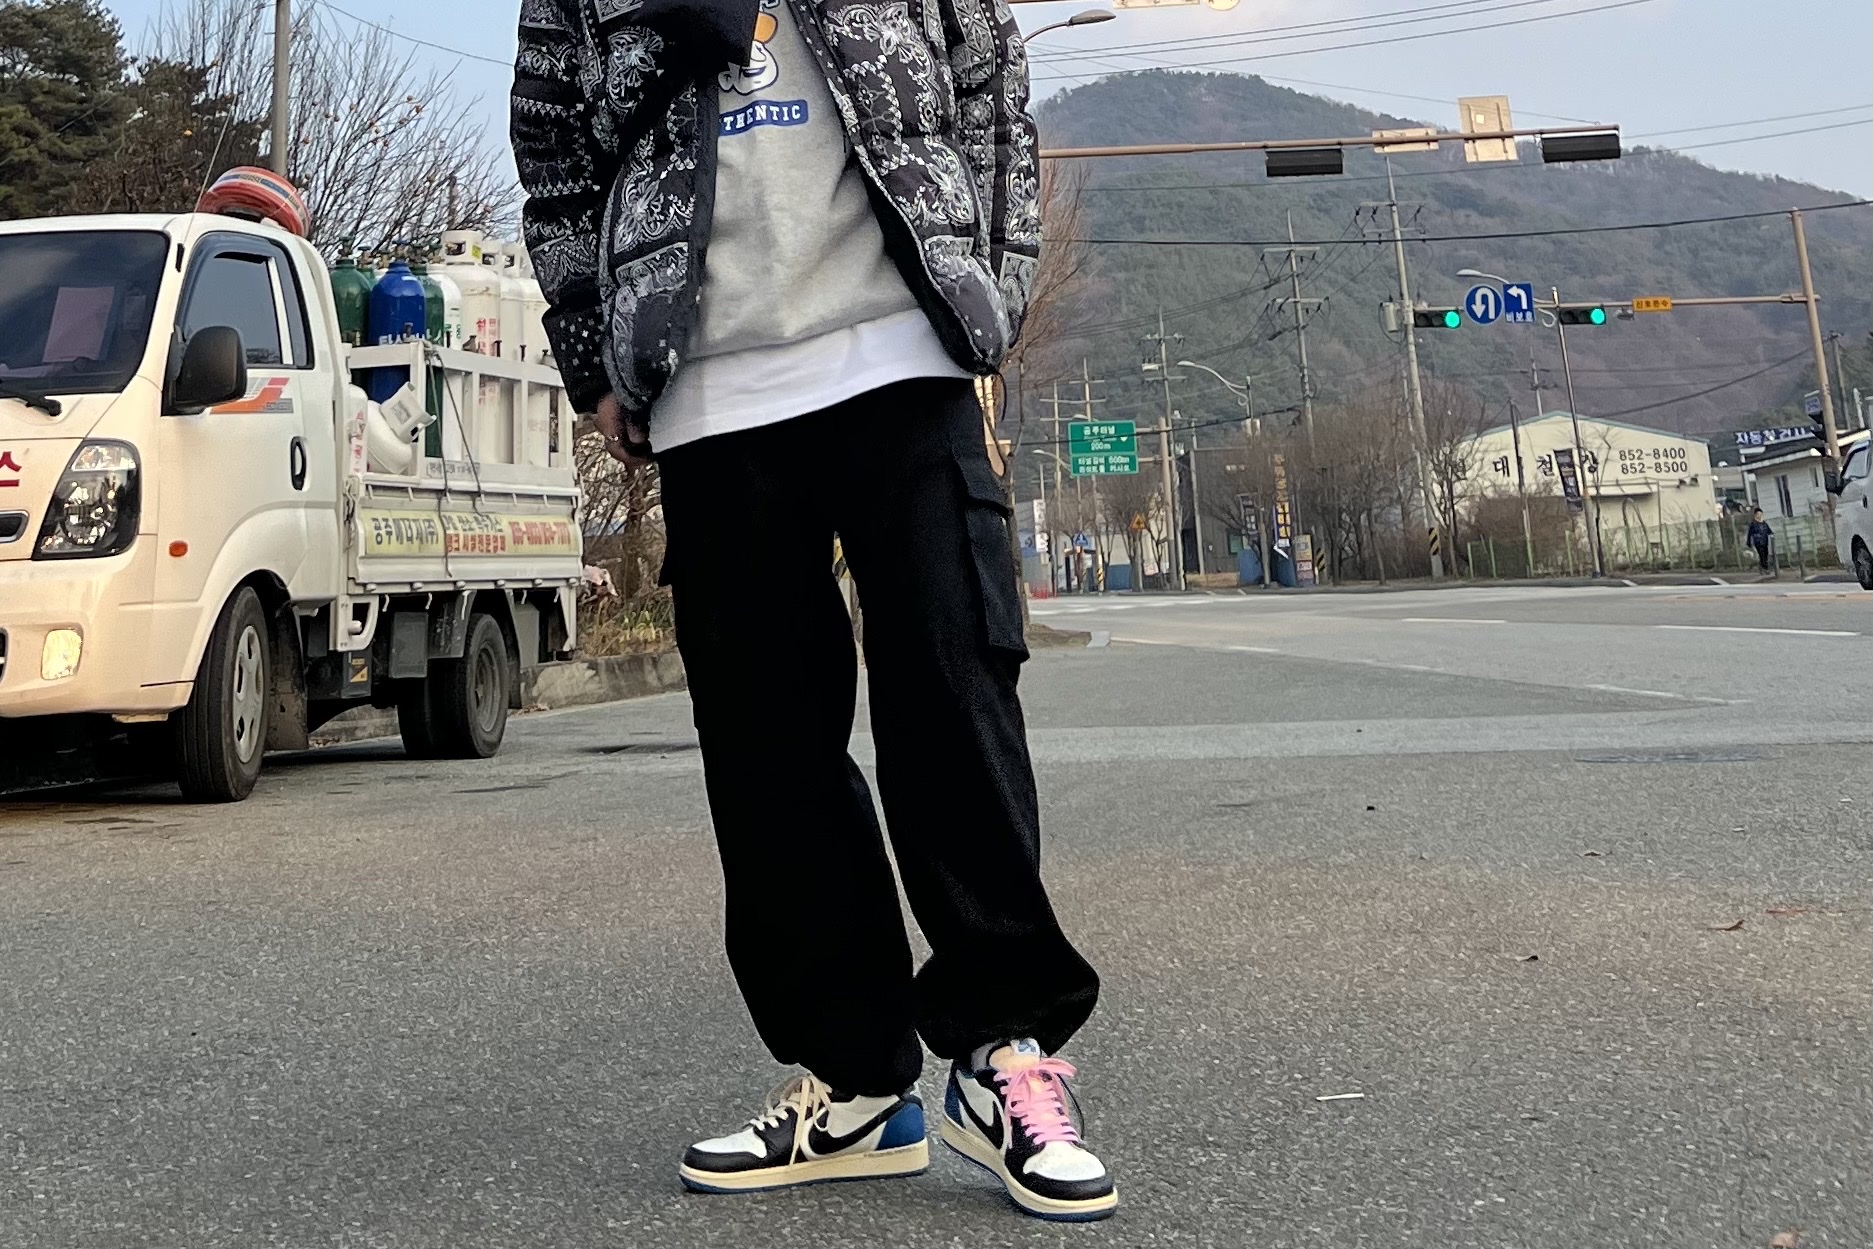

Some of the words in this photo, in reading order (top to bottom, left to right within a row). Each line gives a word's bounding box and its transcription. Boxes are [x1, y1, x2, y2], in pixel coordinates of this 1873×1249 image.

[722, 104, 801, 131] THENTIC
[1505, 311, 1534, 323] 비보호
[1618, 447, 1686, 461] 852-8400
[1620, 461, 1688, 474] 852-8500
